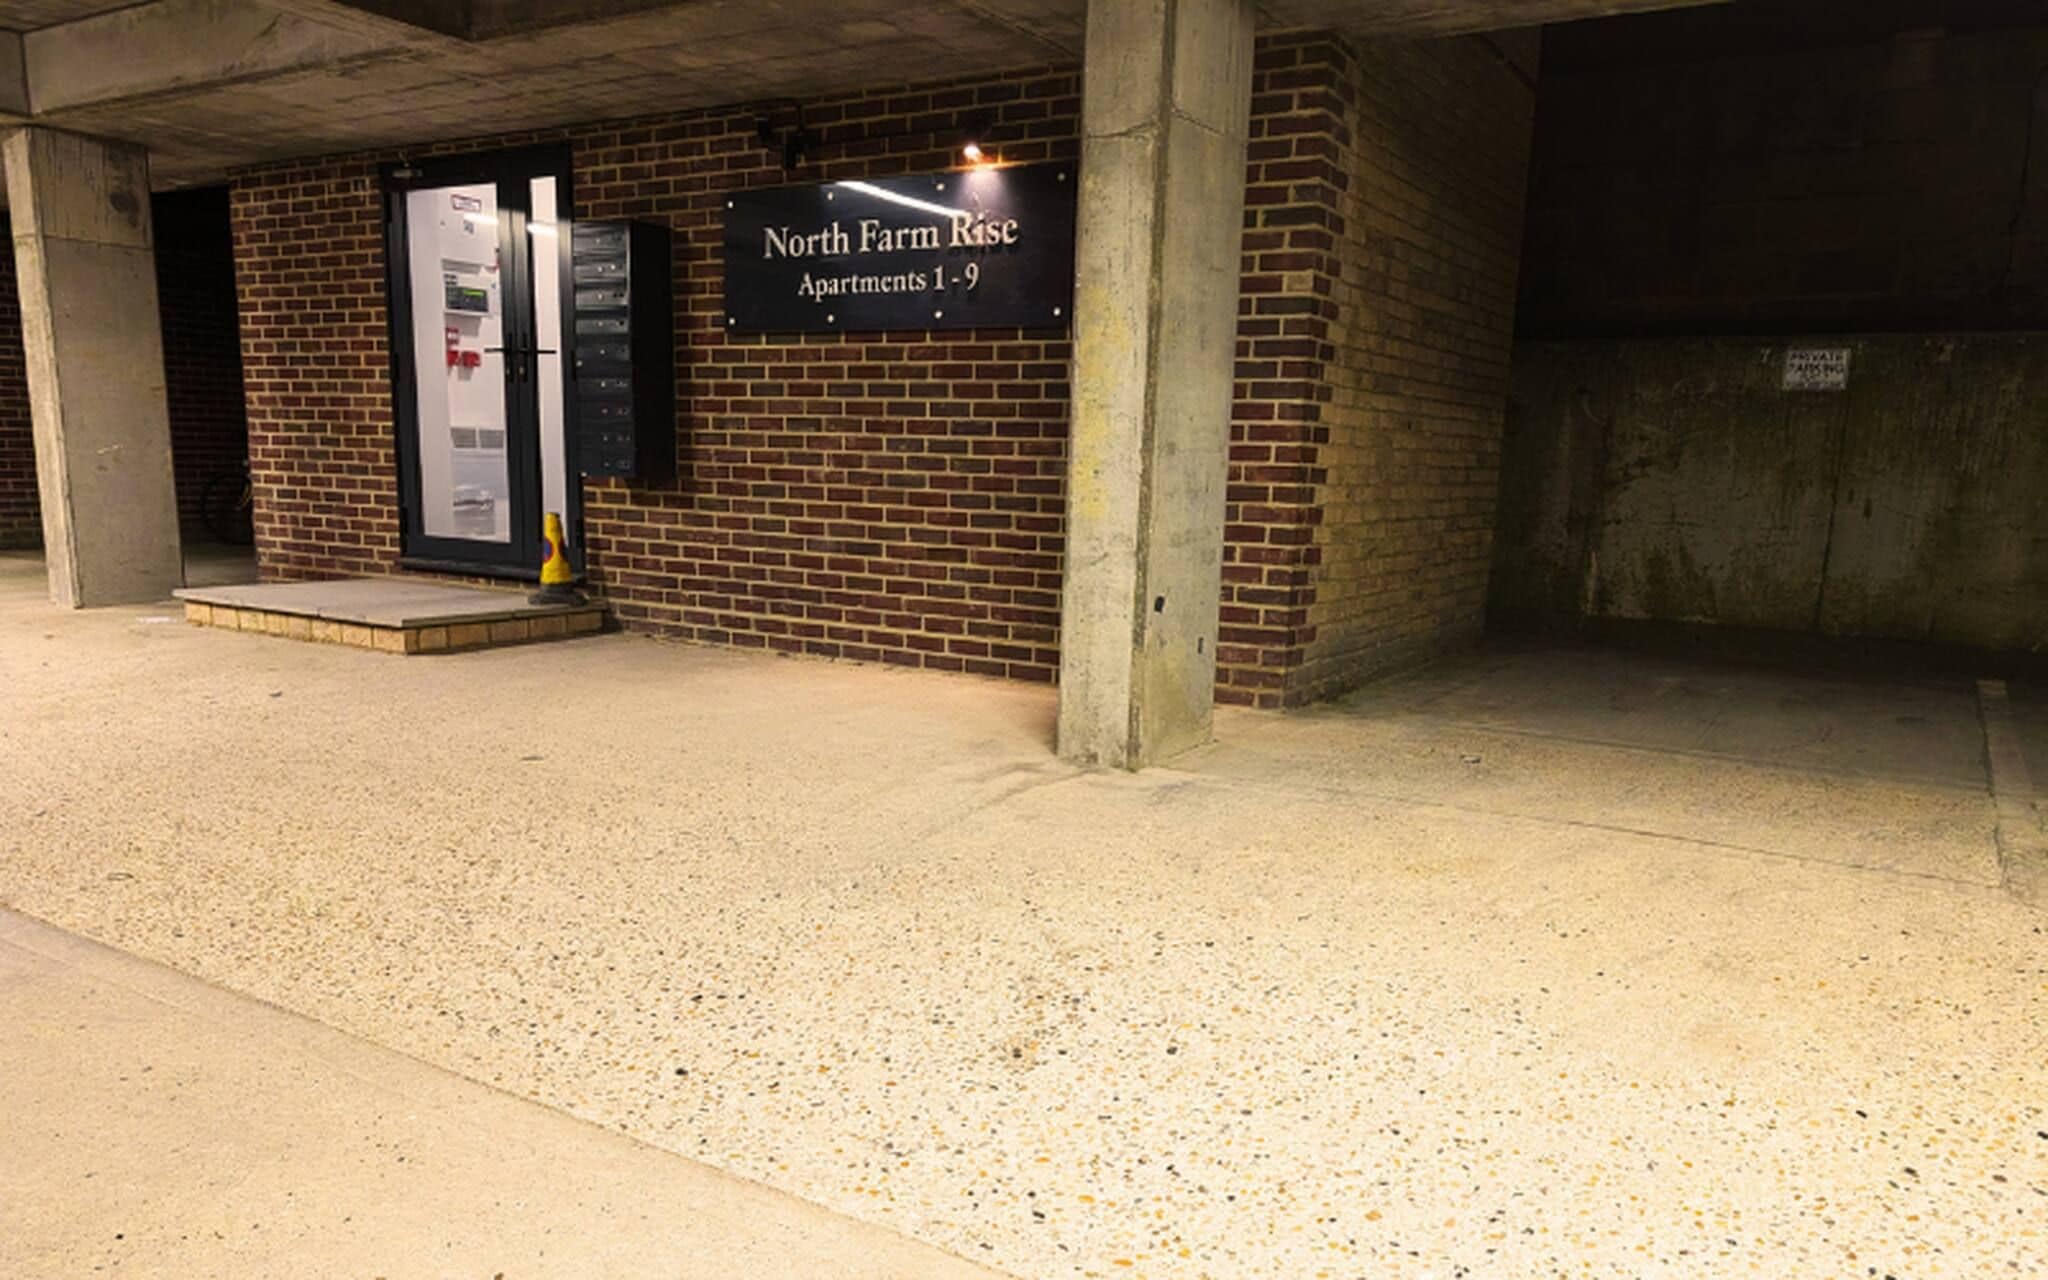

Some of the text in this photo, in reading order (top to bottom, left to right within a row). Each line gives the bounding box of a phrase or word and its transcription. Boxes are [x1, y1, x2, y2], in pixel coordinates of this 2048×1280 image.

[763, 212, 1019, 259] North Farm Rise
[797, 268, 927, 302] Apartments
[933, 265, 946, 291] 1
[965, 262, 980, 291] 9
